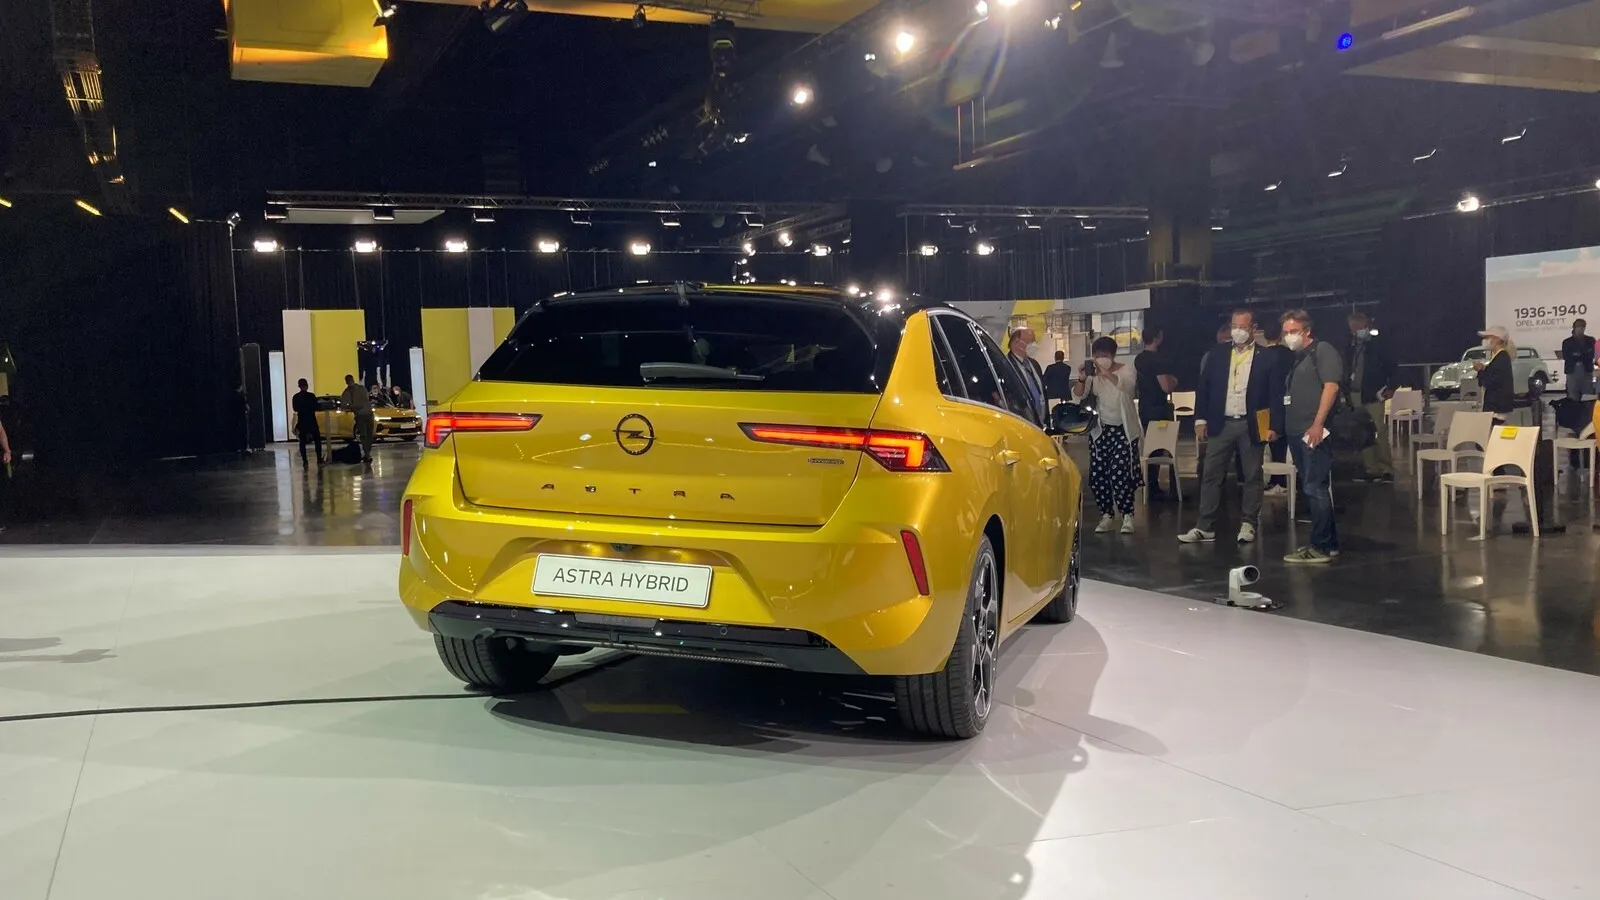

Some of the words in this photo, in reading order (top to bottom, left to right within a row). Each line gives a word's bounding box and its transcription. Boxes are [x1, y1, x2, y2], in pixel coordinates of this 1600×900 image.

[1514, 304, 1587, 319] 1936-1940
[1536, 317, 1567, 326] KADETT
[552, 567, 614, 587] ASTRA
[619, 572, 689, 592] HYBRID
